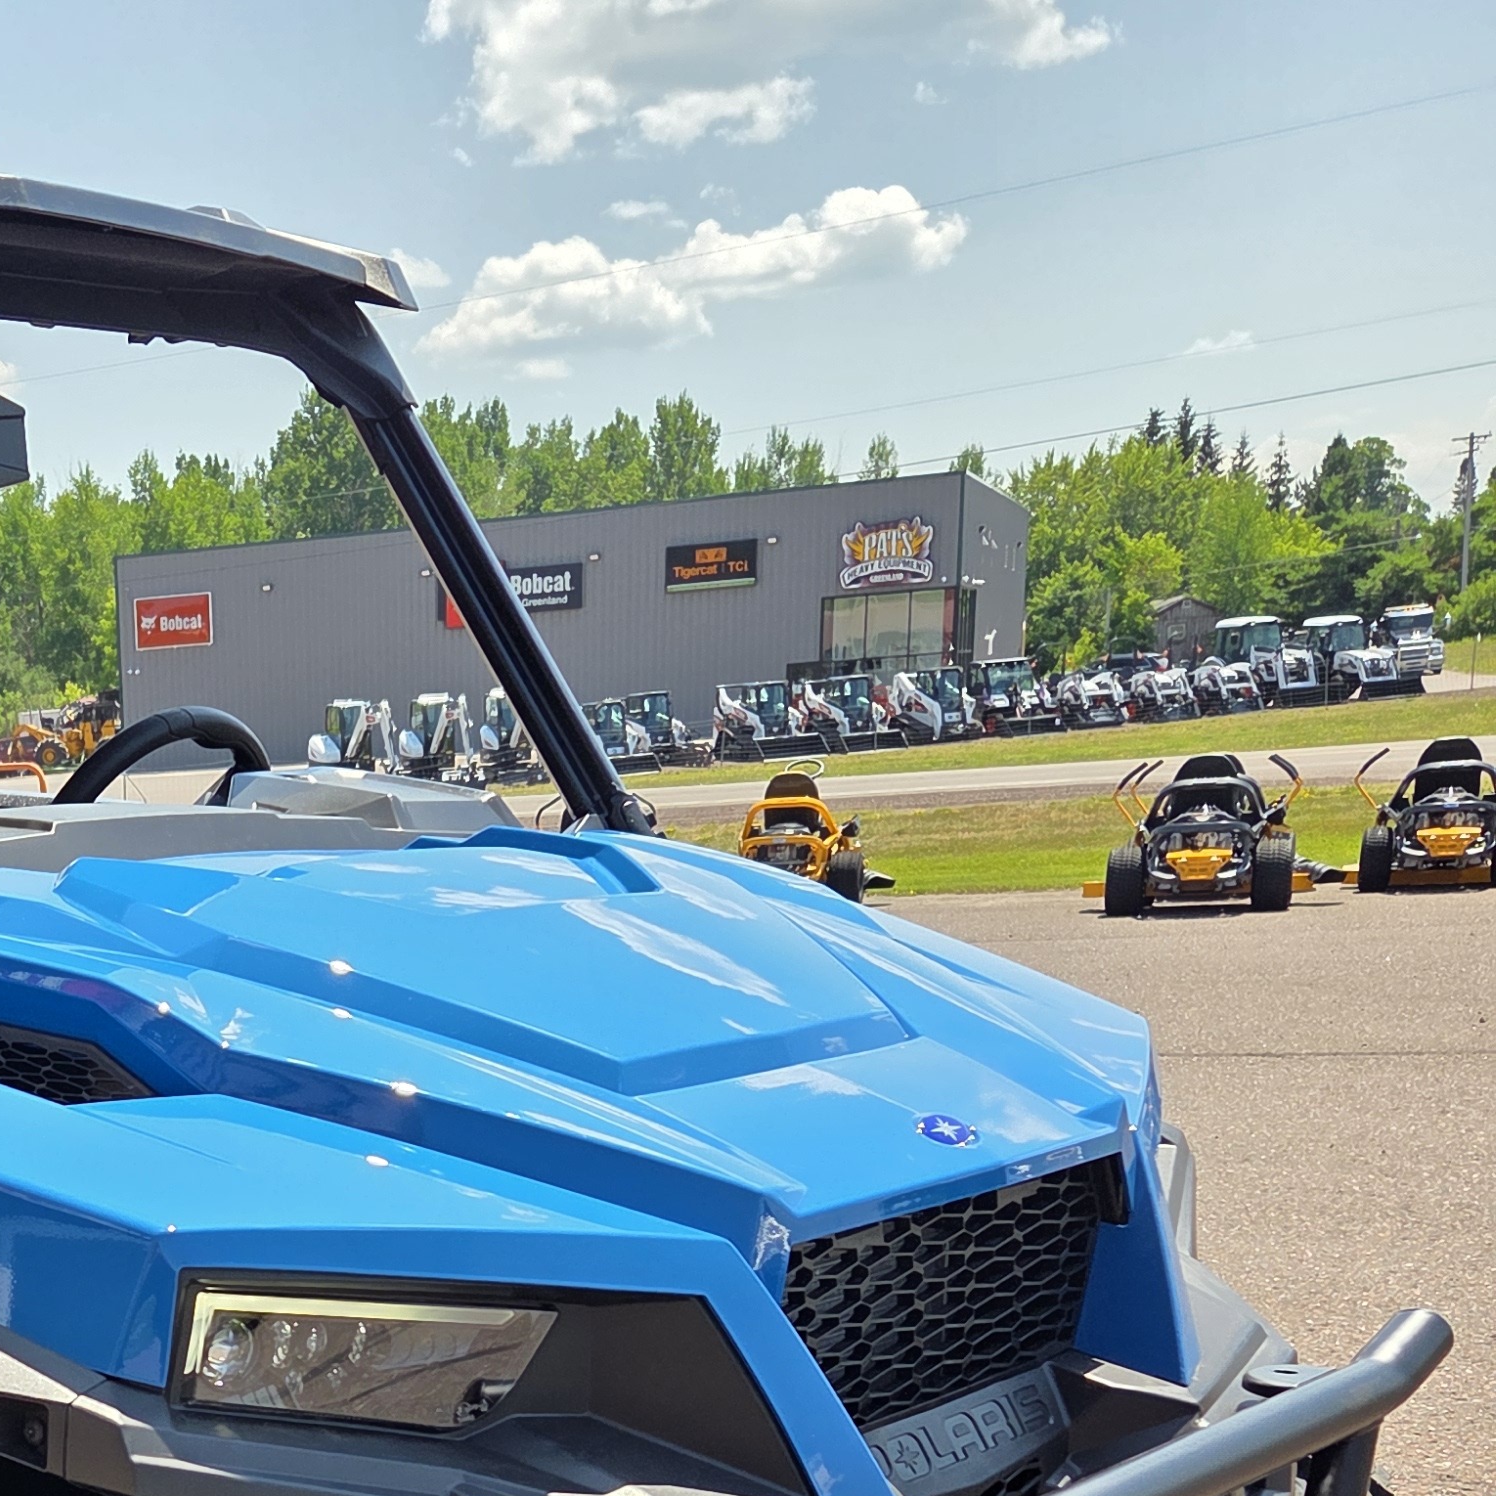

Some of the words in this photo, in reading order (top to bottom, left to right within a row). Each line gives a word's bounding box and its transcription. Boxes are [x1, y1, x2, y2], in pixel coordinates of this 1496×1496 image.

[864, 525, 913, 560] PAT'S
[672, 564, 718, 580] Tigercat
[847, 562, 875, 580] HEAVY
[878, 558, 928, 575] EQUIPMENT
[509, 571, 572, 595] Bobcat
[521, 594, 569, 607] Greenland
[159, 613, 202, 632] Bobcat
